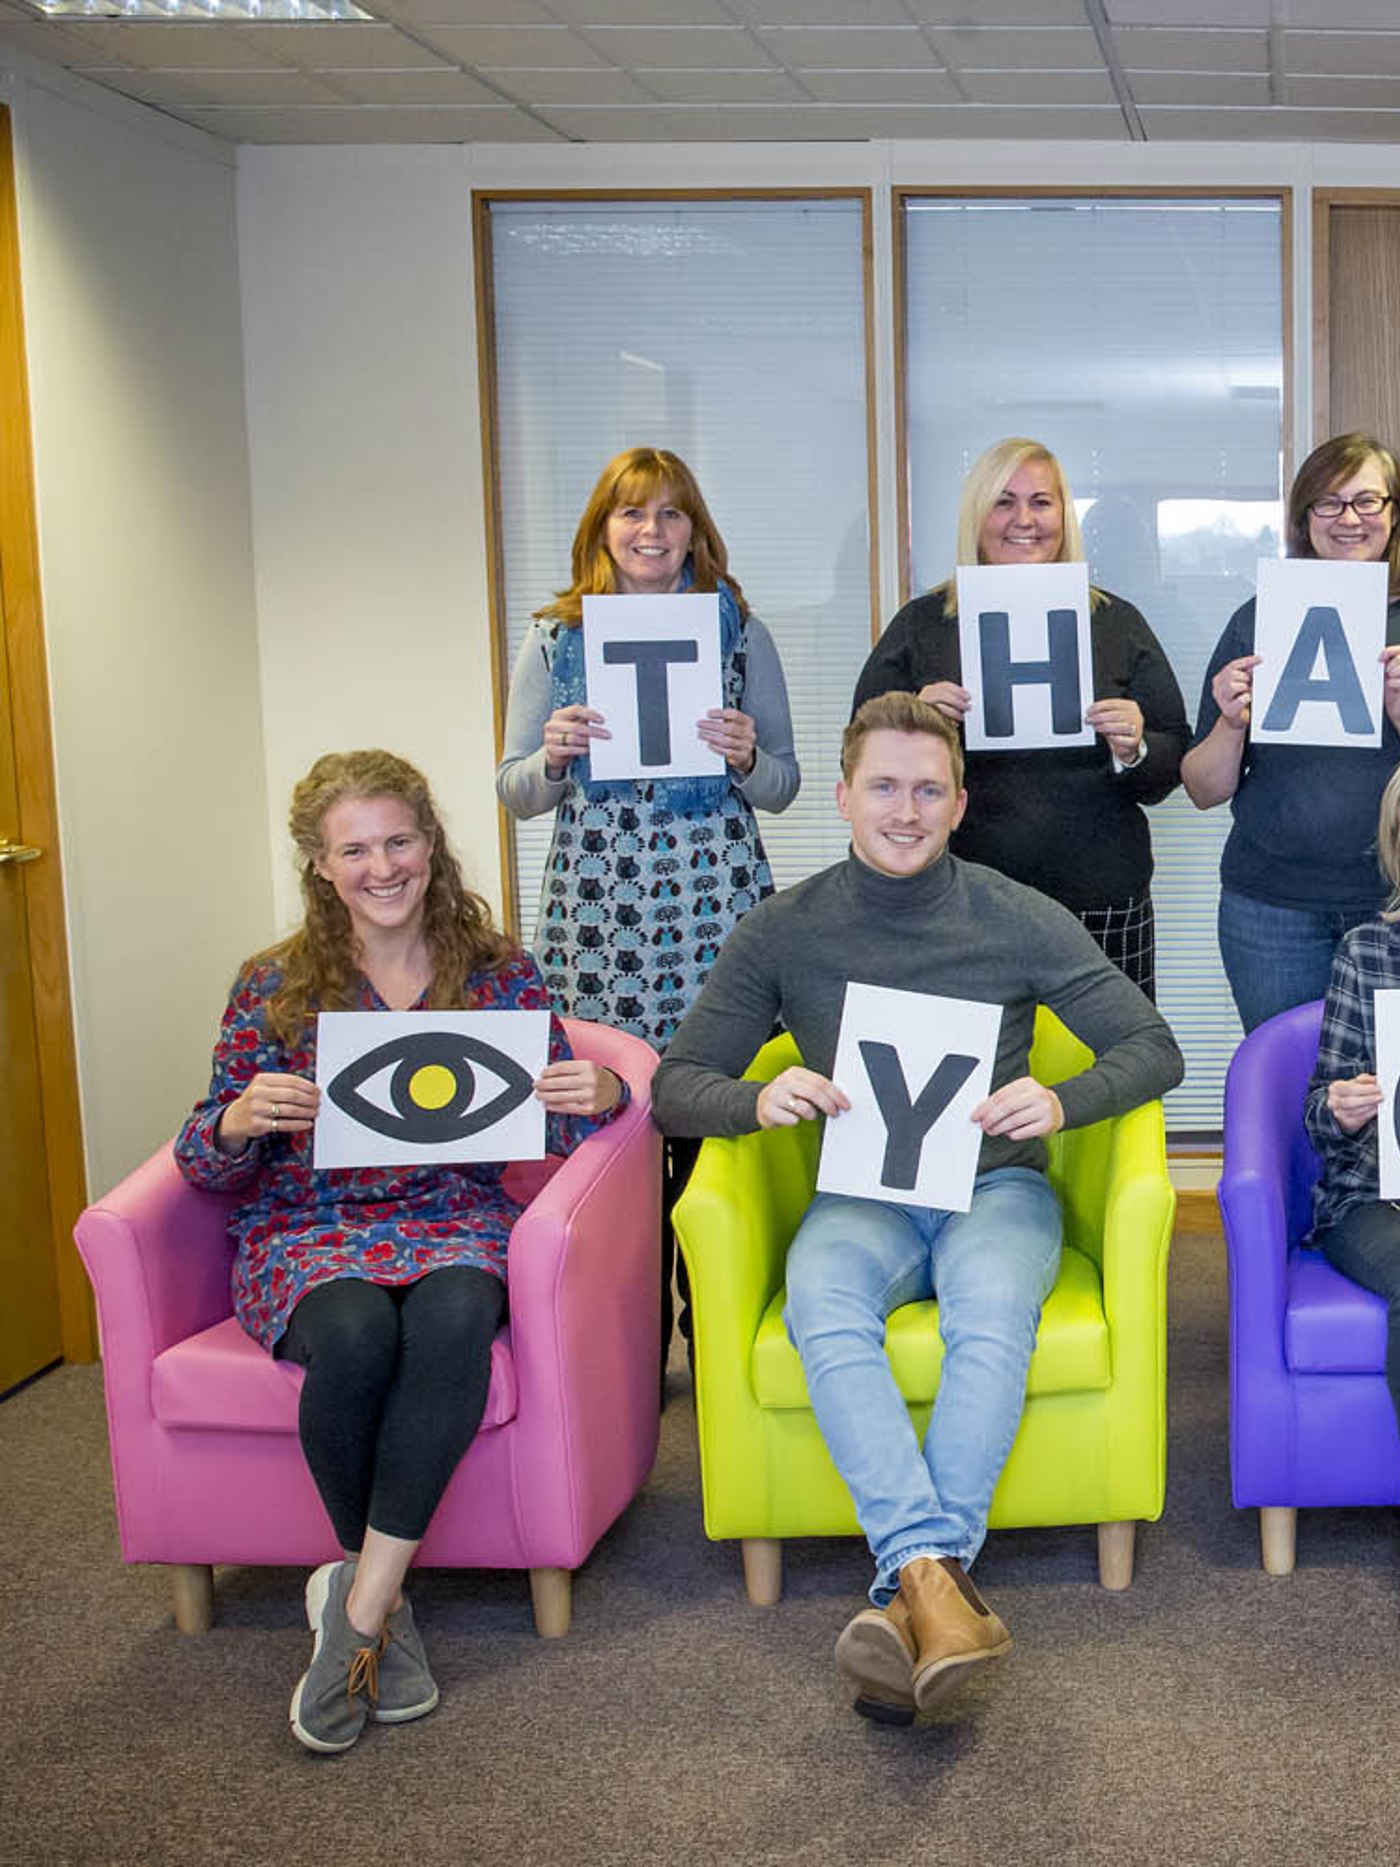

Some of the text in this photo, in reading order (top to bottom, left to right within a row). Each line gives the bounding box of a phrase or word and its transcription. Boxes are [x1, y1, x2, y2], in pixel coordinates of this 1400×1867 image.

[603, 640, 698, 767] T
[979, 610, 1082, 738] H
[1261, 606, 1375, 735] A
[858, 1040, 980, 1190] Y
